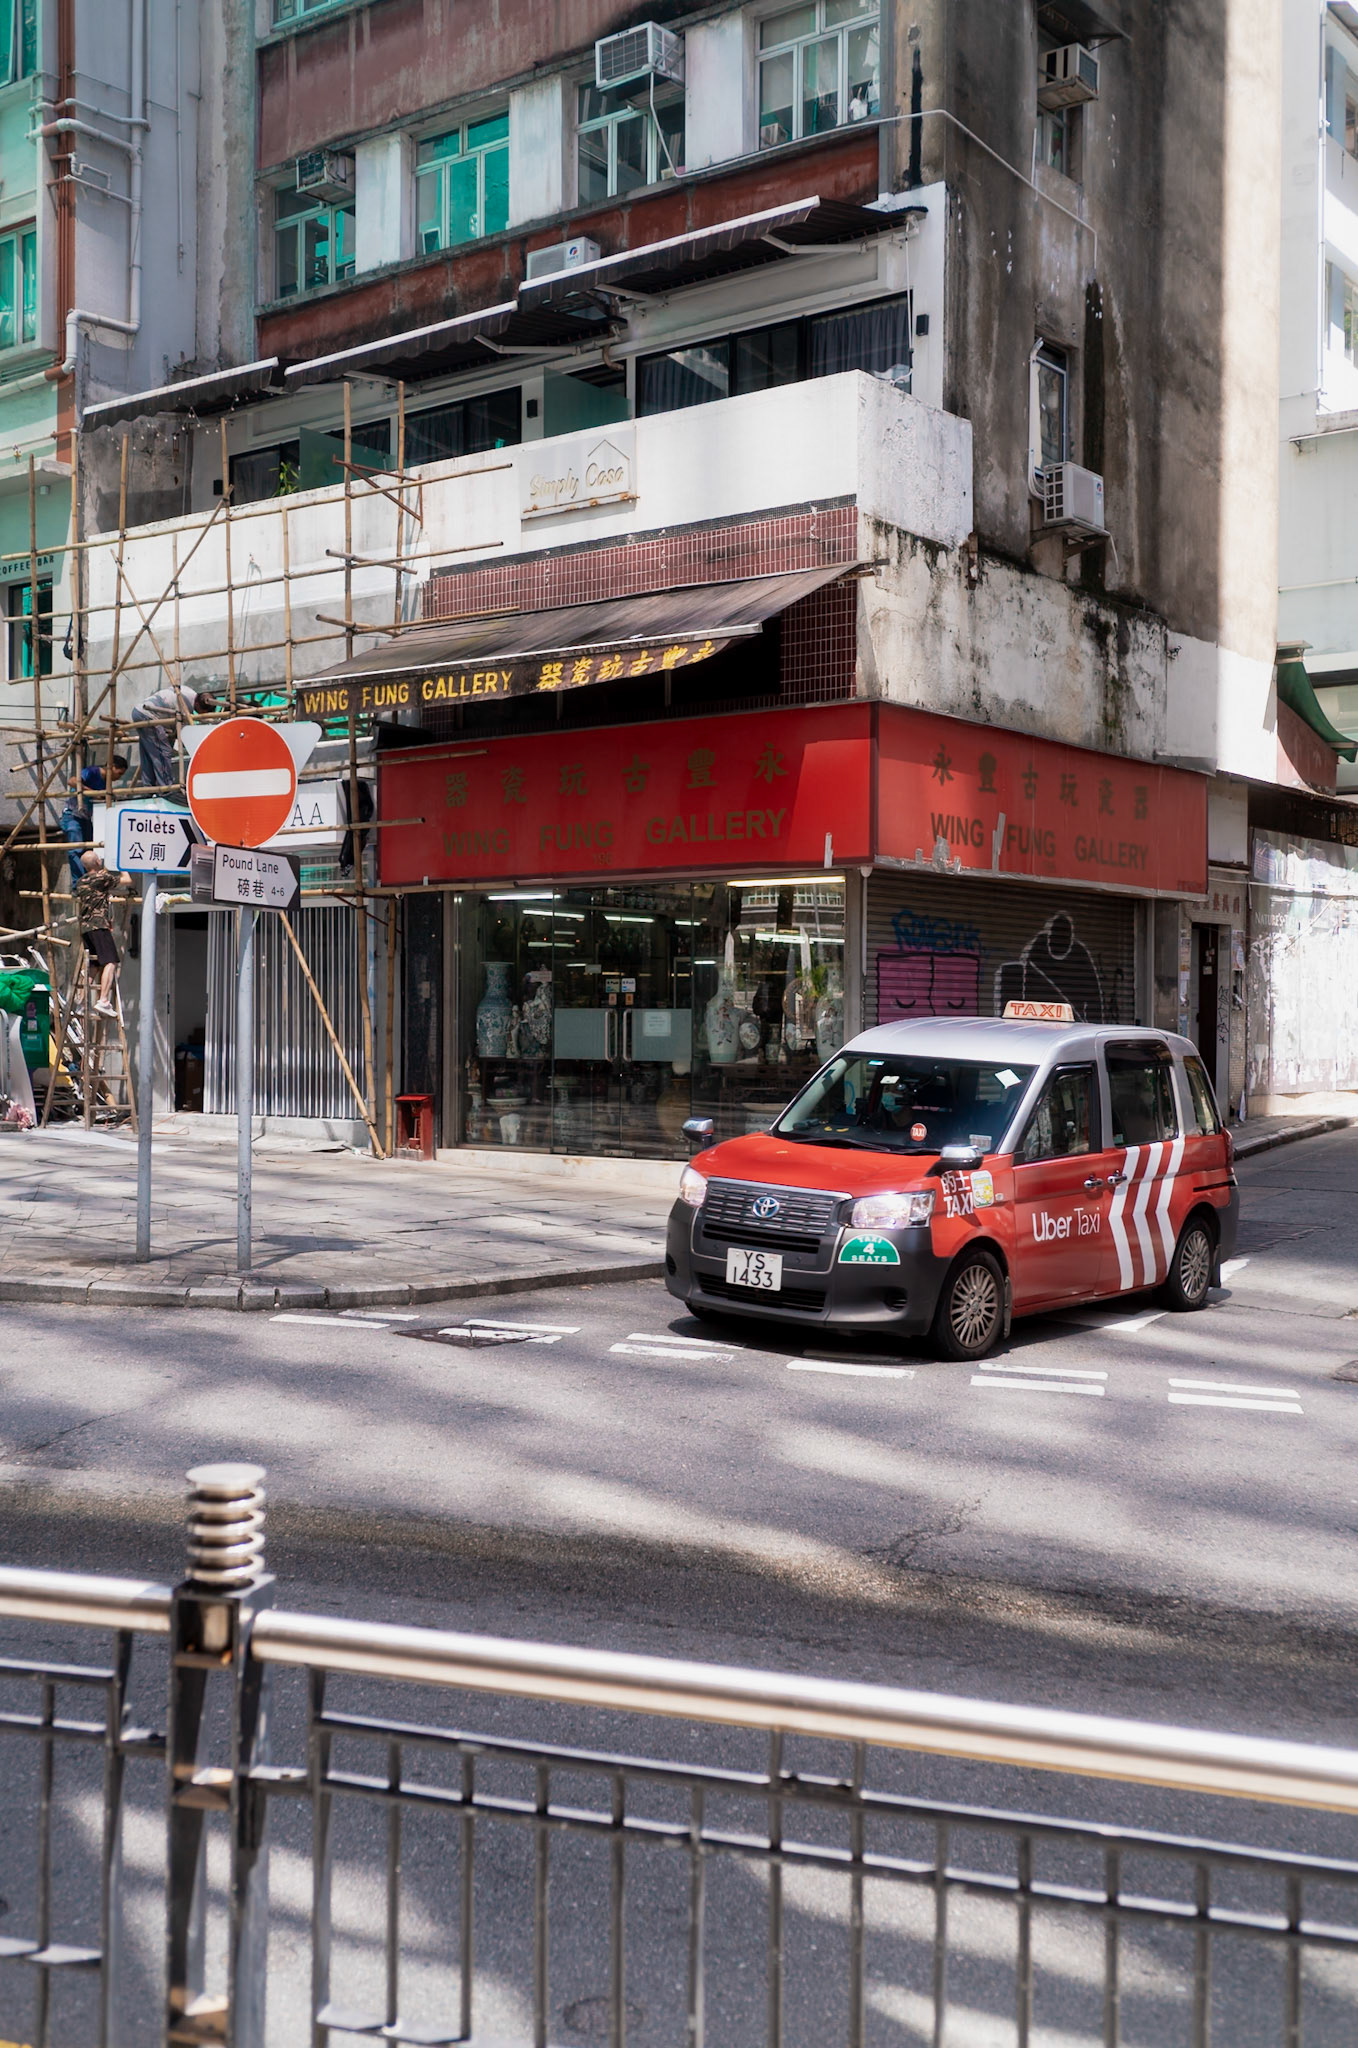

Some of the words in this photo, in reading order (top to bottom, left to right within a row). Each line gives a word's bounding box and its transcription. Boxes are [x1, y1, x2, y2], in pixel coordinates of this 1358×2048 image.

[530, 468, 579, 503] Simply
[586, 463, 624, 488] Casa
[0, 560, 30, 576] OFFEE
[37, 555, 54, 567] BAR
[303, 688, 348, 714] WING
[362, 683, 409, 708] FUNG
[422, 670, 512, 700] GALLERY
[128, 818, 175, 835] Toilets
[443, 828, 510, 856] WING
[540, 820, 613, 850] FUNG
[646, 808, 786, 845] GALLERY
[128, 841, 166, 862] 公廁
[931, 812, 984, 848] WING
[1006, 824, 1055, 857] FUNG
[1075, 835, 1148, 871] GALLERY
[222, 854, 253, 871] Pound
[256, 858, 279, 874] Lane
[237, 878, 264, 898] 磅巷
[271, 886, 285, 897] 4-6
[1011, 1003, 1062, 1017] TAXI
[911, 1127, 926, 1137] TAXI
[941, 1170, 971, 1195] 的士
[943, 1192, 974, 1218] TAXI
[1032, 1212, 1072, 1242] Uber
[1074, 1207, 1100, 1236] Taxi
[858, 1234, 882, 1243] TAXI
[863, 1243, 875, 1255] 4
[744, 1251, 766, 1270] YS
[733, 1266, 774, 1288] 1433
